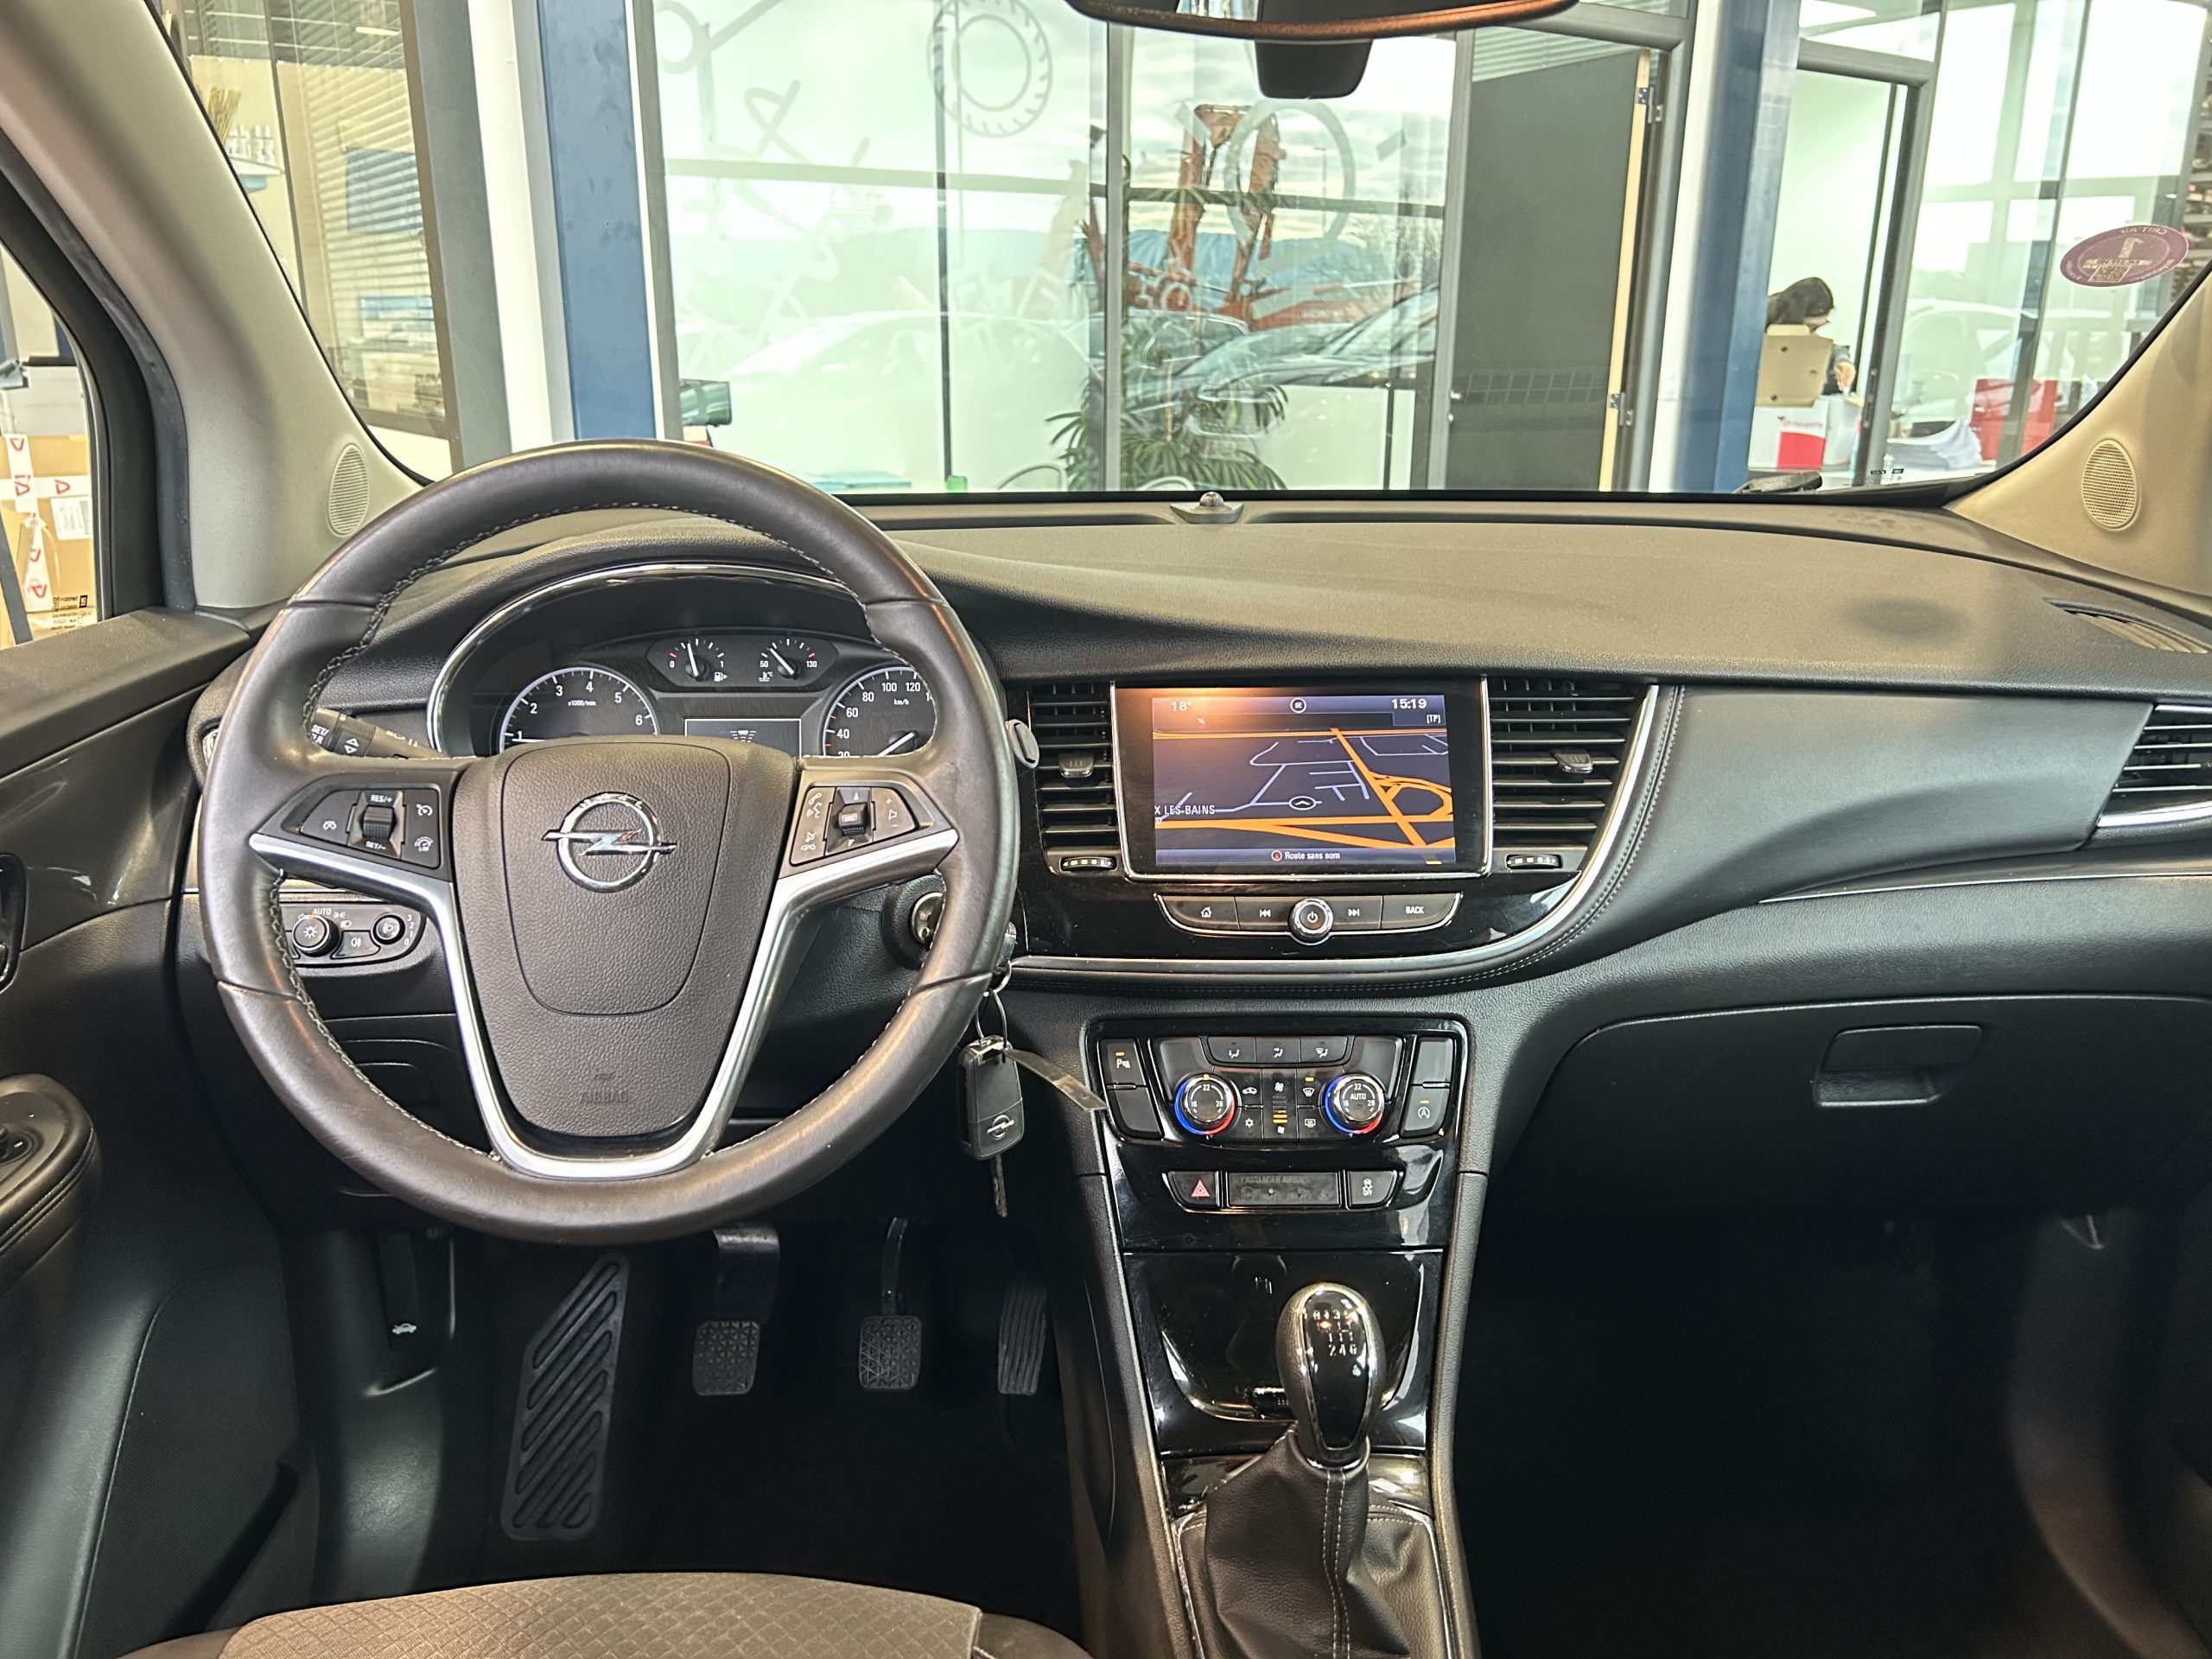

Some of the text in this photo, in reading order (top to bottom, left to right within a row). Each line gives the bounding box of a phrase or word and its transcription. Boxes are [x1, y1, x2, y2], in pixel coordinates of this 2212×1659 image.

[556, 685, 563, 696] 3
[586, 682, 594, 692] 4
[882, 683, 897, 691] 100
[906, 683, 920, 691] 120
[614, 692, 622, 703] 5
[862, 692, 874, 702] 80
[530, 702, 537, 714] 2
[1391, 698, 1427, 709] 15:19
[847, 708, 858, 717] 60
[635, 715, 643, 726] 6
[1427, 715, 1440, 723] [TP]
[518, 731, 523, 740] 1
[836, 728, 849, 739] 40
[1285, 851, 1305, 860] Route
